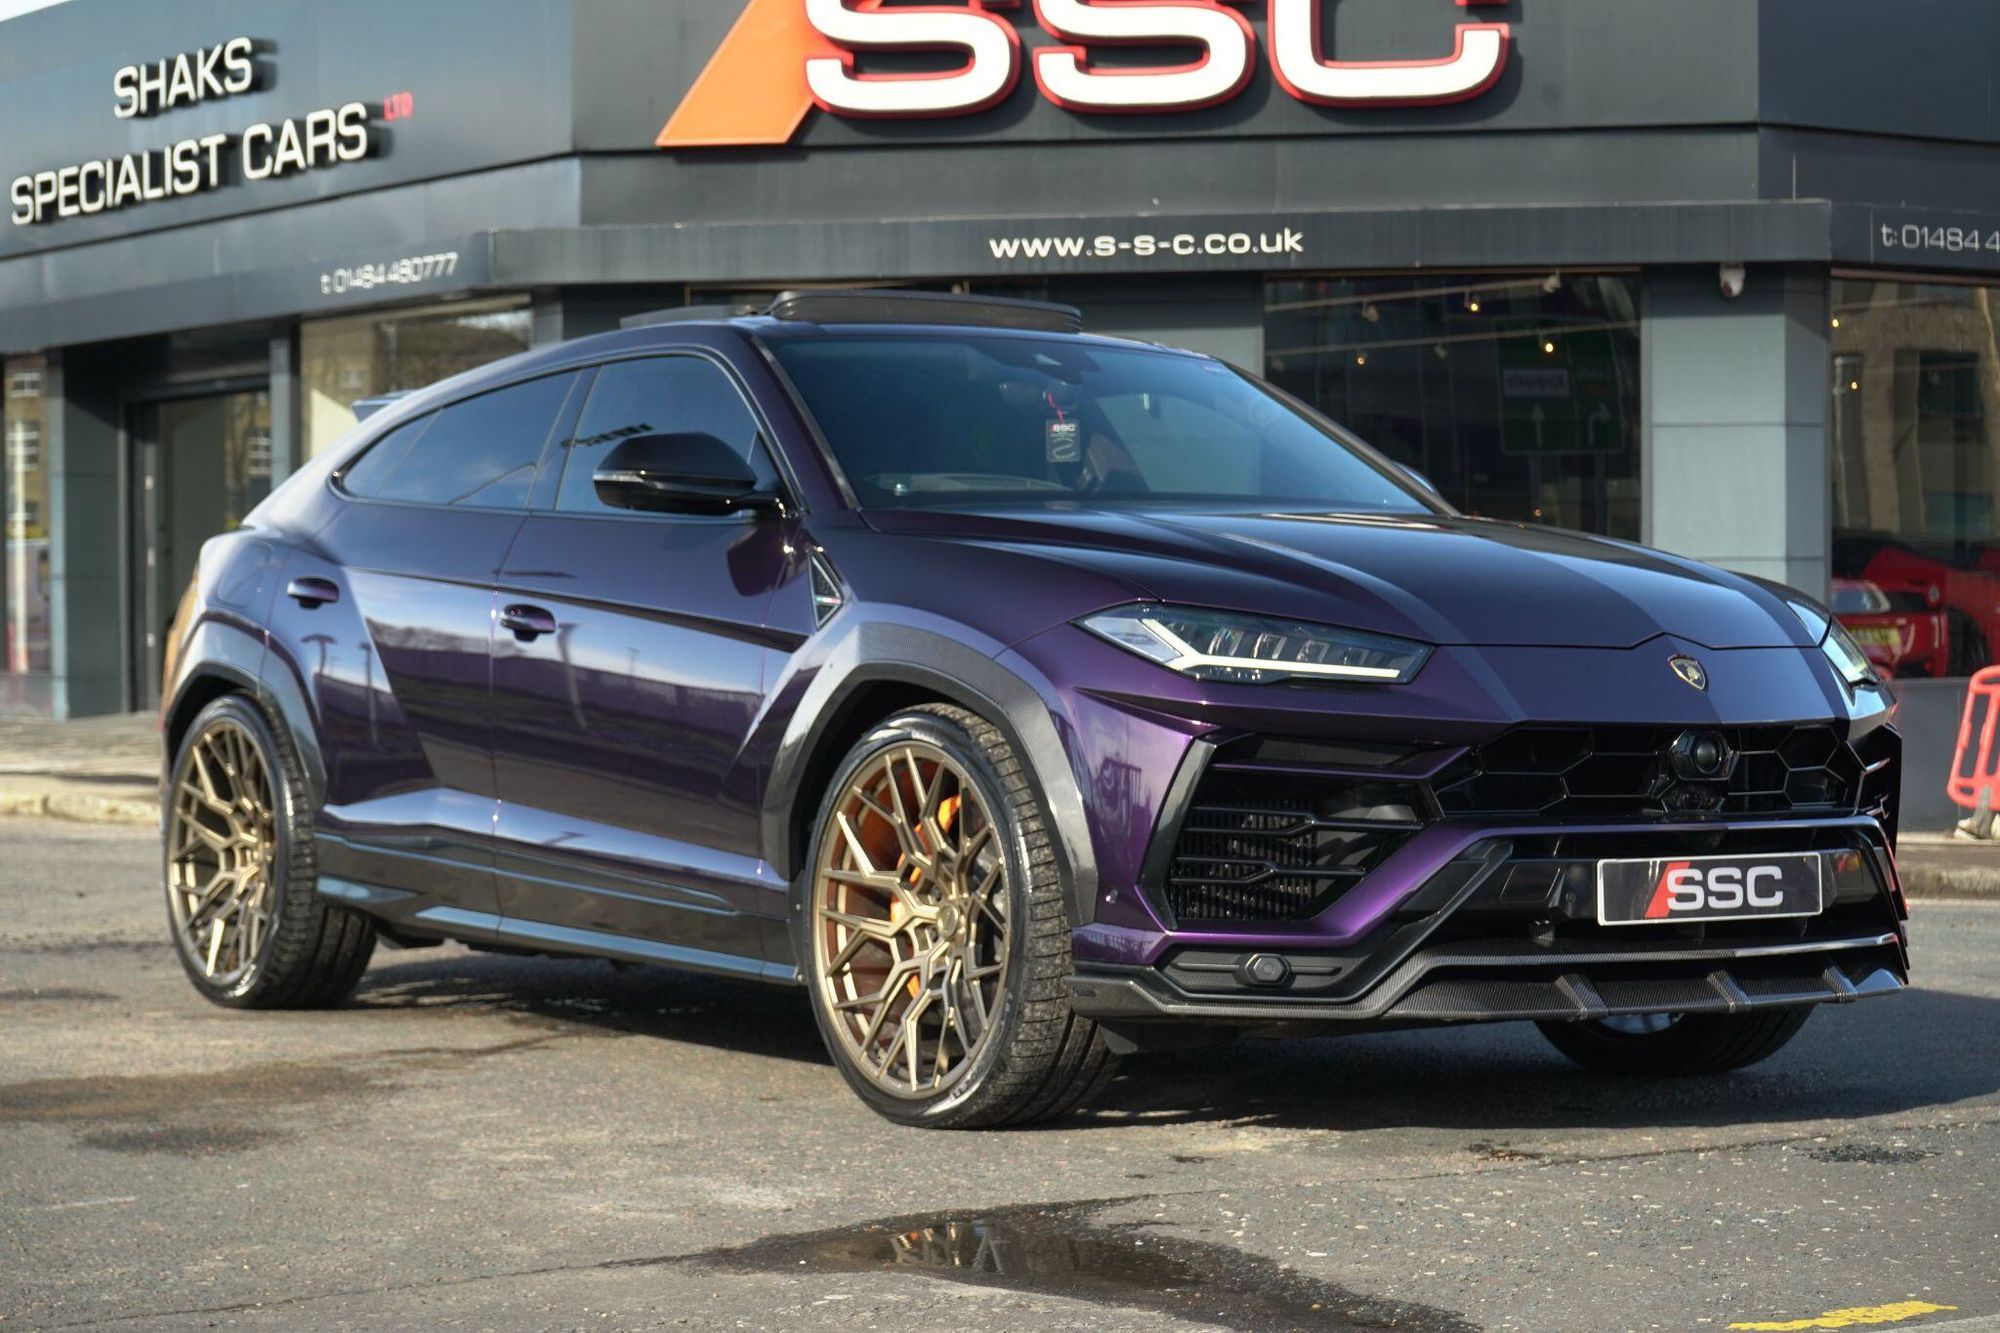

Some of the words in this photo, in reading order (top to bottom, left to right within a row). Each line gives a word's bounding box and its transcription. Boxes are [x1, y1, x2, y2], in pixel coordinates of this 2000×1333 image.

[113, 37, 252, 119] SHAKS
[801, 0, 1509, 117] SSC
[11, 133, 227, 225] SPECIALIST
[243, 102, 368, 179] CARS
[989, 228, 1304, 258] www.s-s-c.co.uk
[1667, 865, 1784, 911] SSC
